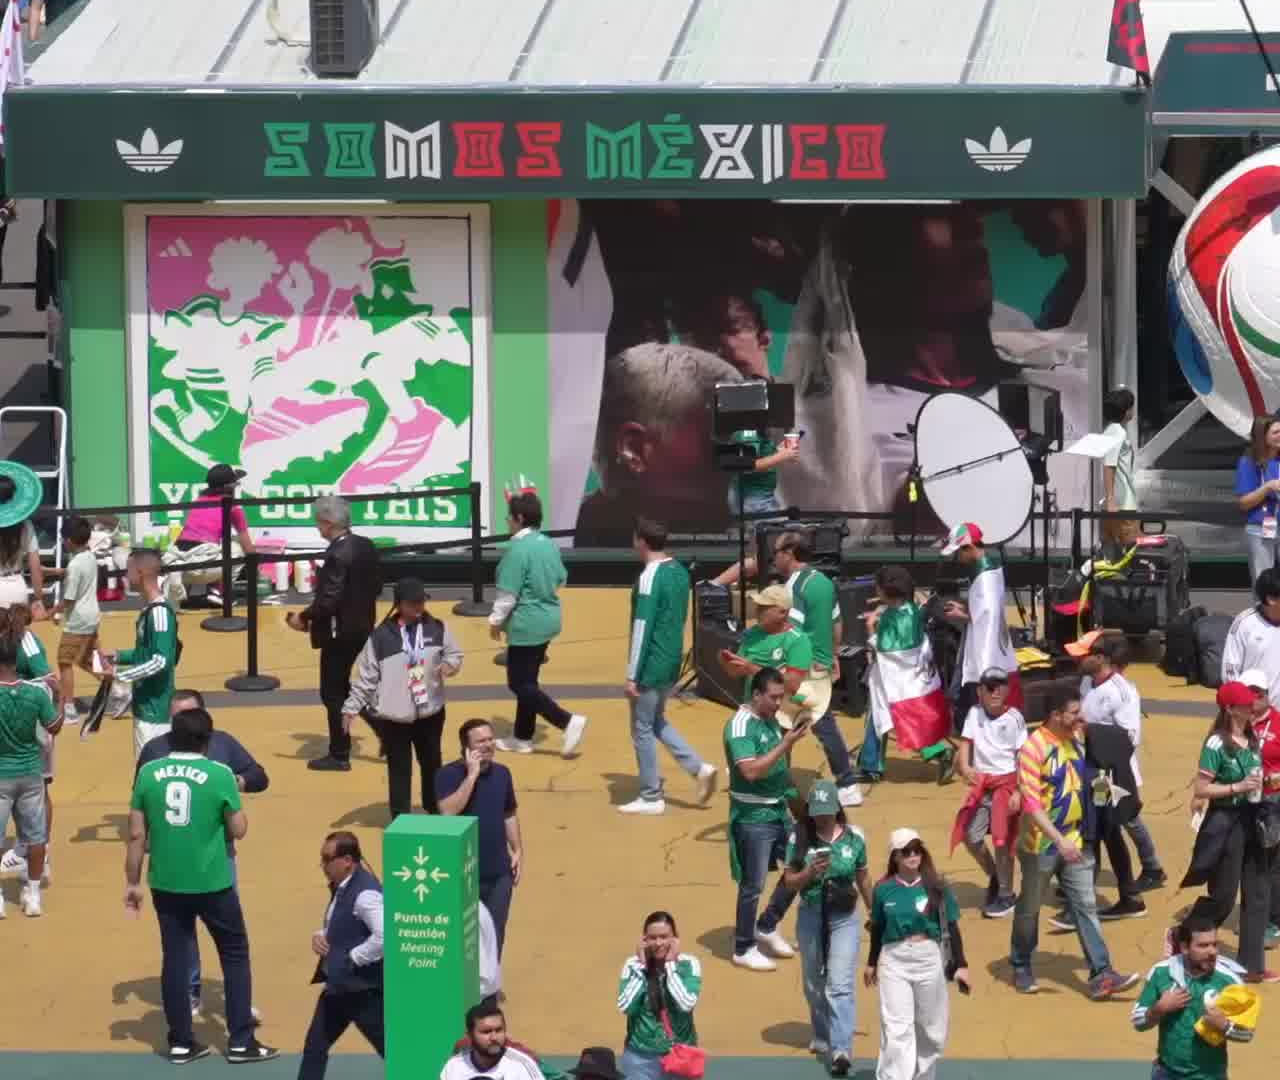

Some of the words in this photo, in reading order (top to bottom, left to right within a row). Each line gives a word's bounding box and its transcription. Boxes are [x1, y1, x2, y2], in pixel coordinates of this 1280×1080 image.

[264, 121, 562, 179] SOMOS
[587, 115, 887, 184] MÉXICO
[153, 765, 208, 784] MEXICO
[165, 782, 191, 826] 9
[394, 912, 430, 924] Punto
[434, 912, 449, 924] de
[398, 926, 446, 940] reunión
[400, 943, 444, 956] Meeting
[408, 958, 438, 968] Point
